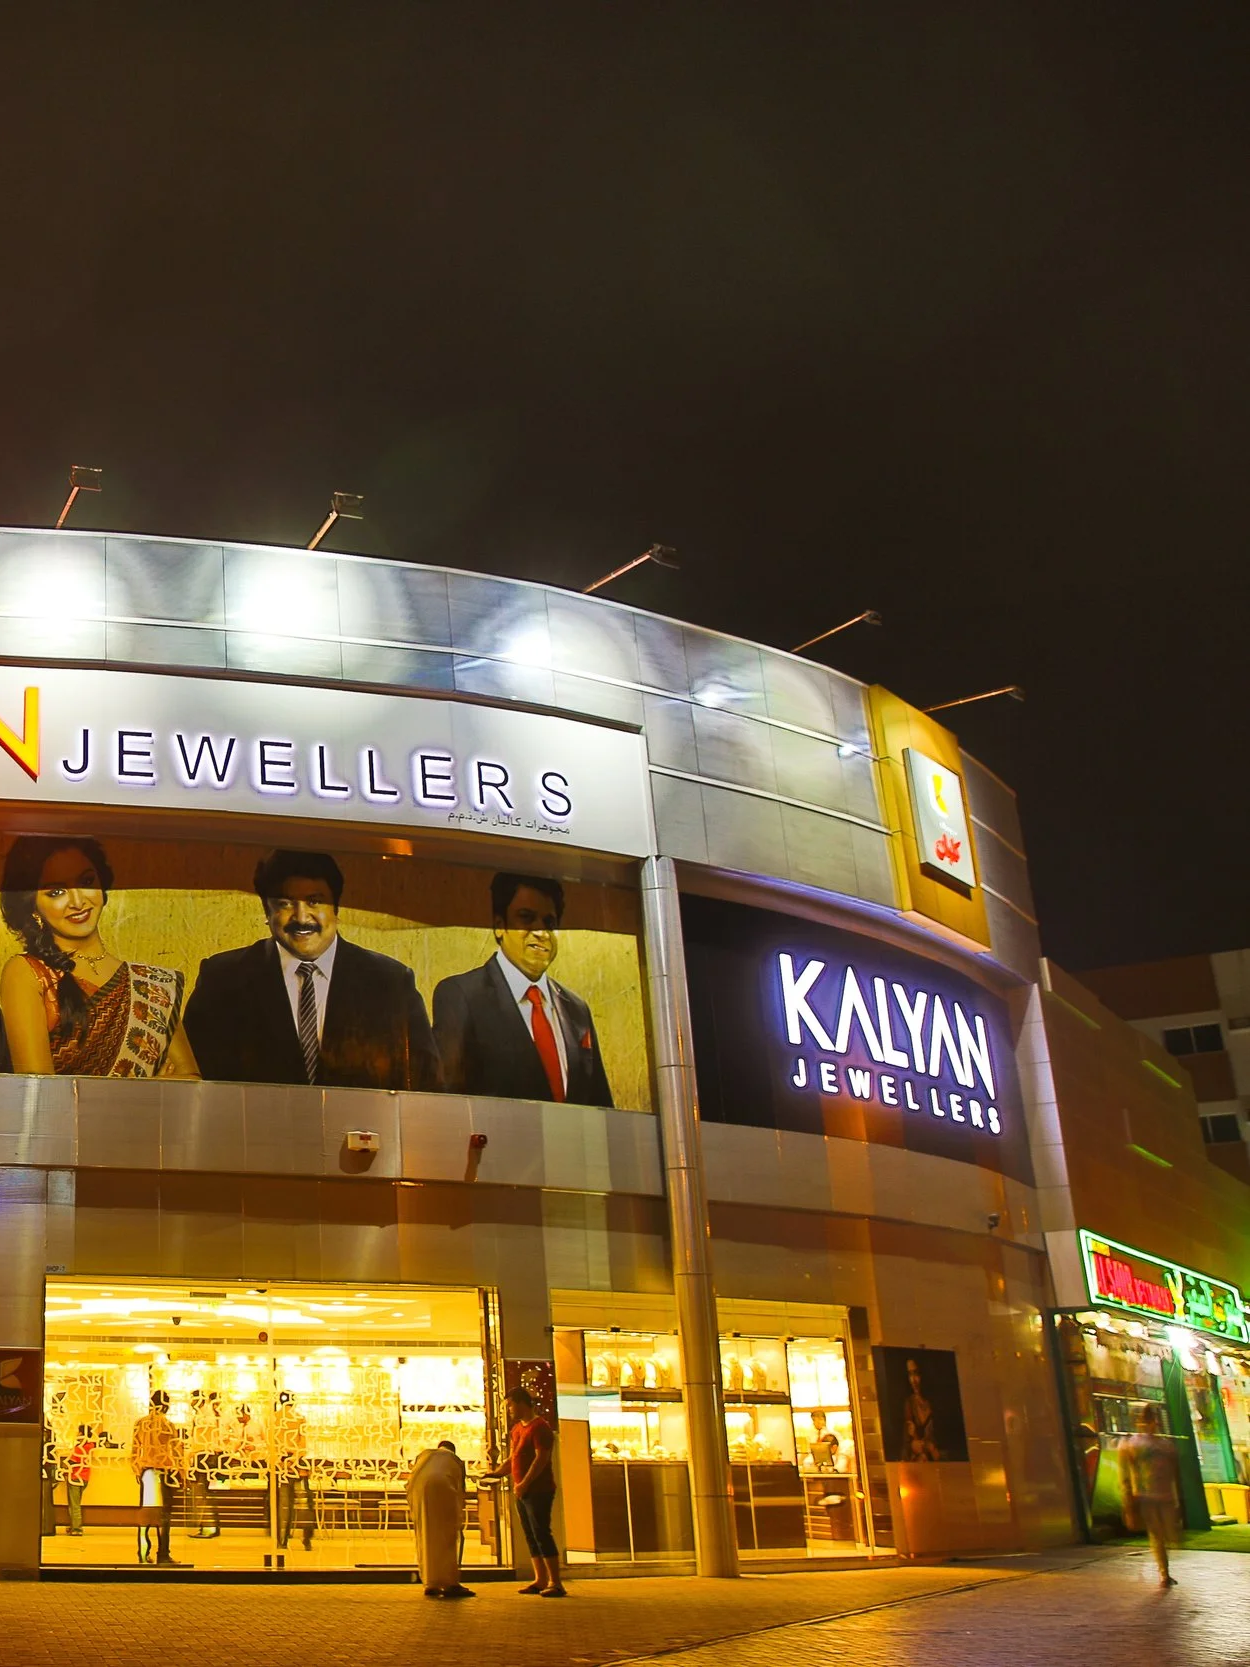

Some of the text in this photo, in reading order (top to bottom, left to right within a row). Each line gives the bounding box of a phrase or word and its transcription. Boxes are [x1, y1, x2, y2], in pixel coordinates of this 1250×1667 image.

[61, 727, 573, 818] JEWELLERS
[525, 820, 570, 834] مجوهرات
[779, 953, 996, 1100] KALYAN
[792, 1059, 1001, 1135] JEWELLERS
